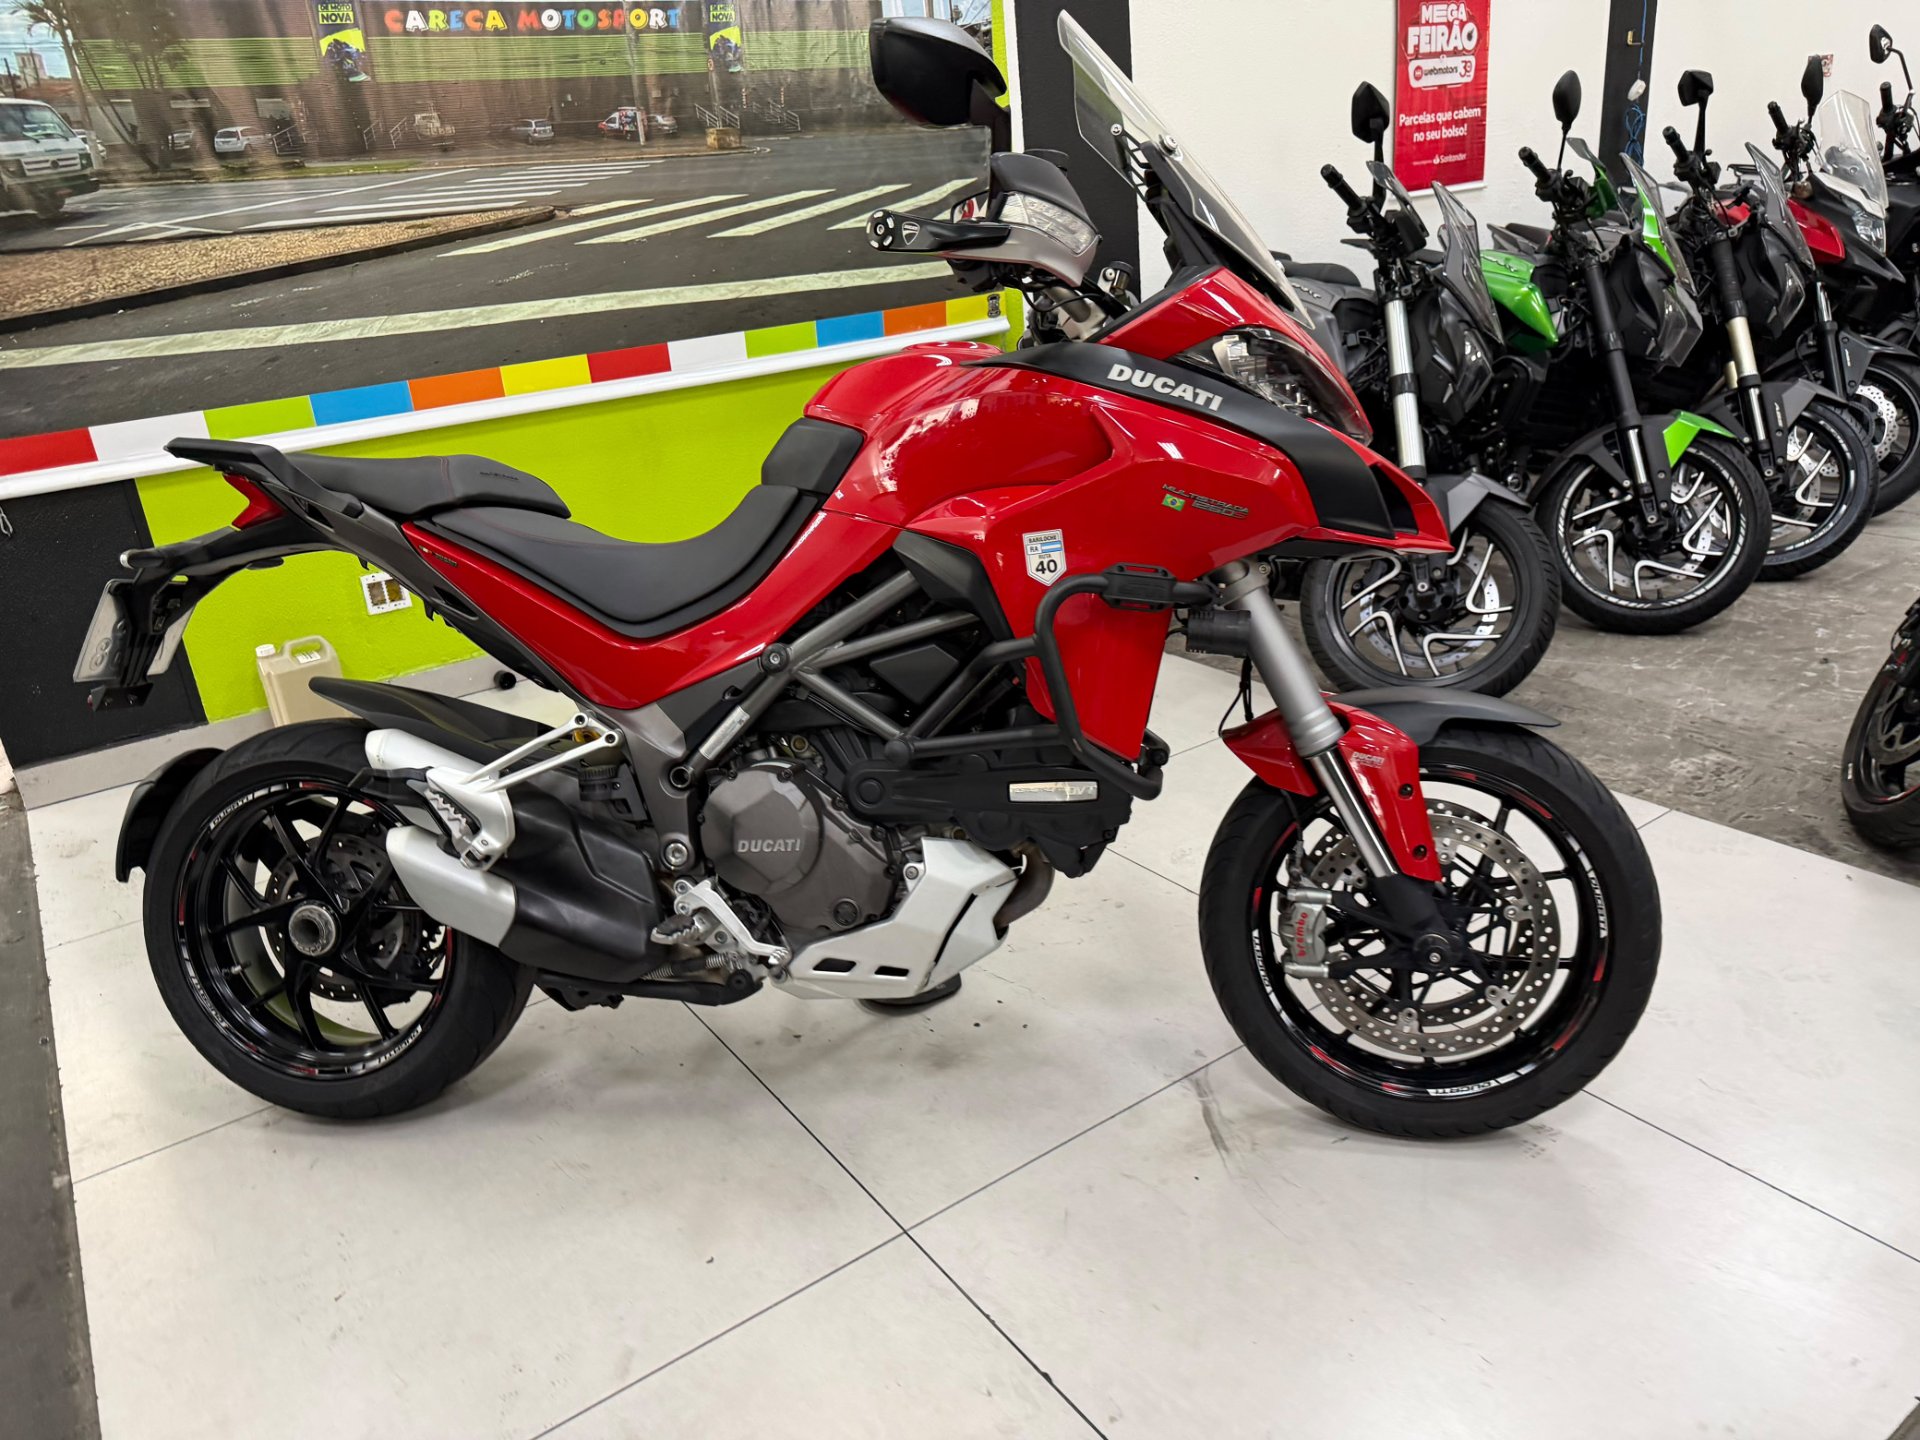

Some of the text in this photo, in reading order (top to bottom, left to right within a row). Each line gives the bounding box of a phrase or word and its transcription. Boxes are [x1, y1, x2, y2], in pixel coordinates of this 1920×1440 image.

[320, 12, 352, 23] NOVA
[384, 8, 680, 31] CARECA MOTOSPORT
[711, 12, 734, 21] NOVA
[1421, 2, 1467, 24] MEGA
[1407, 20, 1478, 54] FEIRÃO
[1424, 65, 1458, 76] webmotors
[1399, 106, 1481, 127] Parcelas que cabem
[1413, 123, 1468, 142] no seu bolso!
[1440, 153, 1467, 163] Santander
[1107, 364, 1223, 412] DUCATI
[1035, 559, 1058, 574] 40
[737, 839, 801, 853] DUCATI
[1296, 912, 1309, 957] brembo
